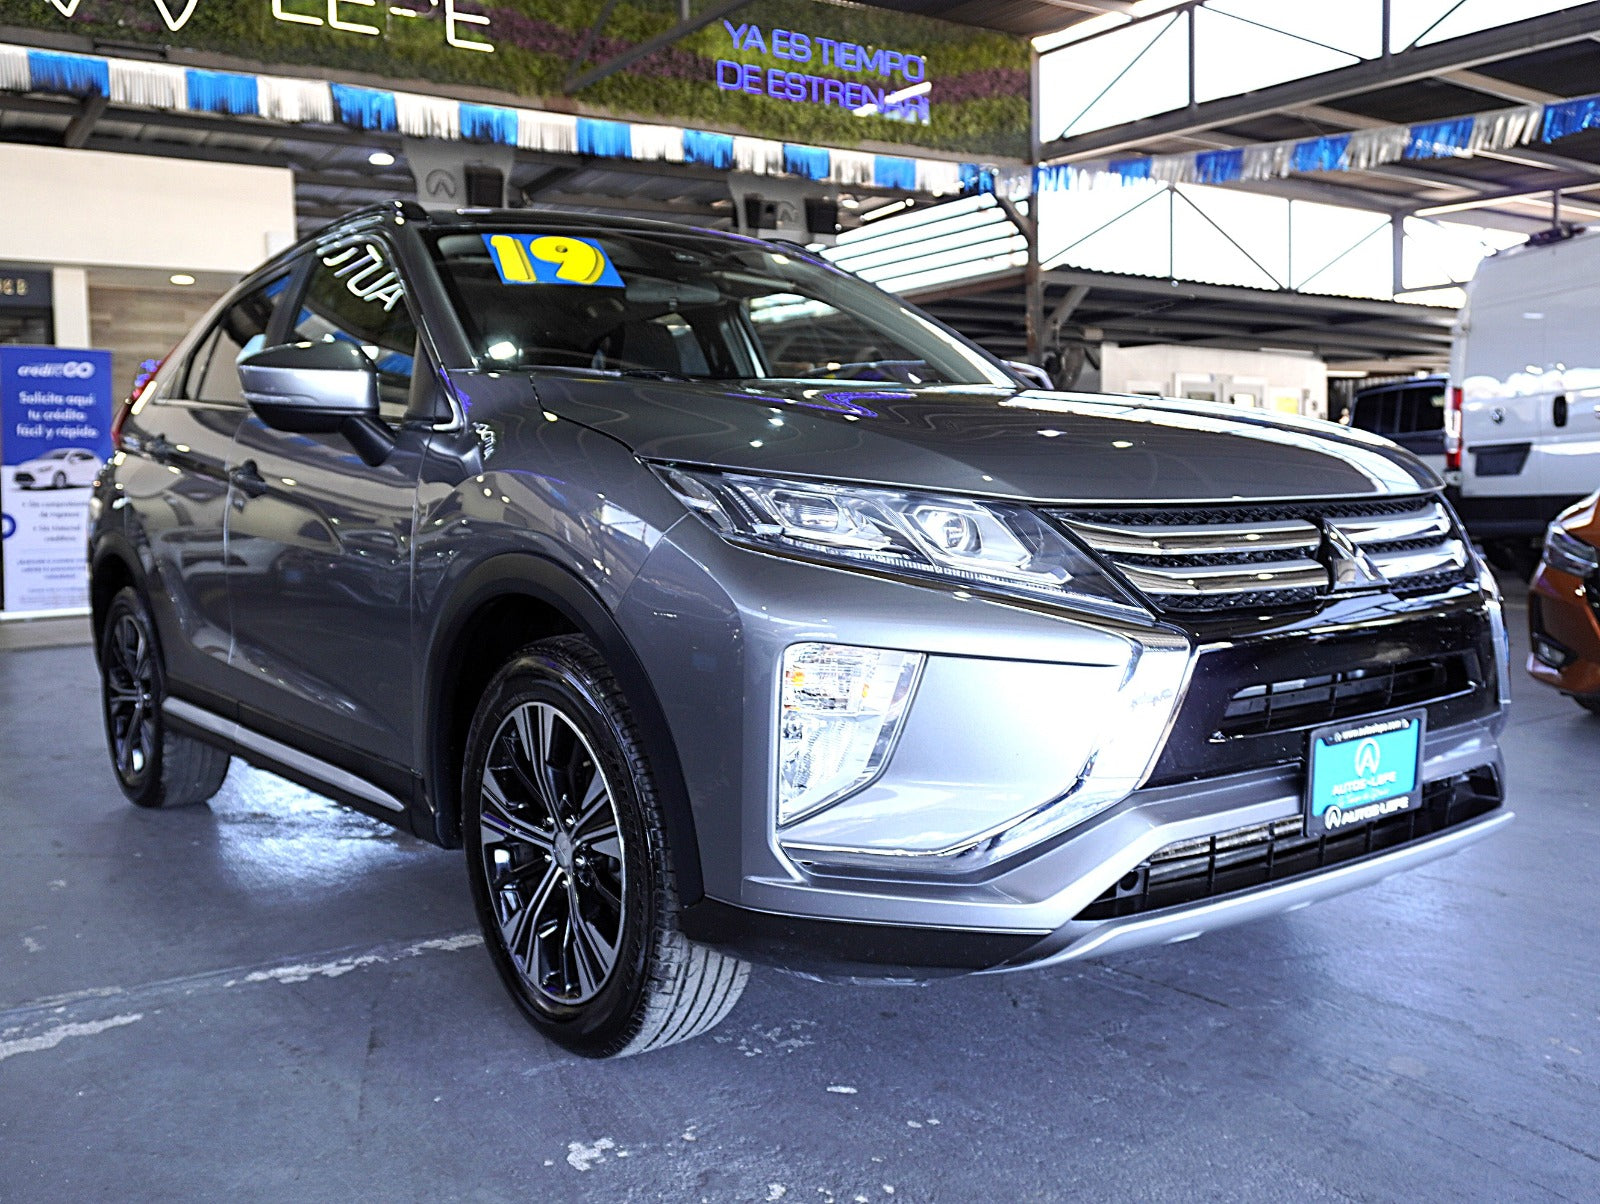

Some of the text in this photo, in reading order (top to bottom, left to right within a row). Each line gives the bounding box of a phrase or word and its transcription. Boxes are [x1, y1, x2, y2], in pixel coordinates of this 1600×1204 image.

[723, 19, 925, 82] YA ES TIEMPO
[716, 59, 762, 94] DE
[491, 234, 605, 285] 19
